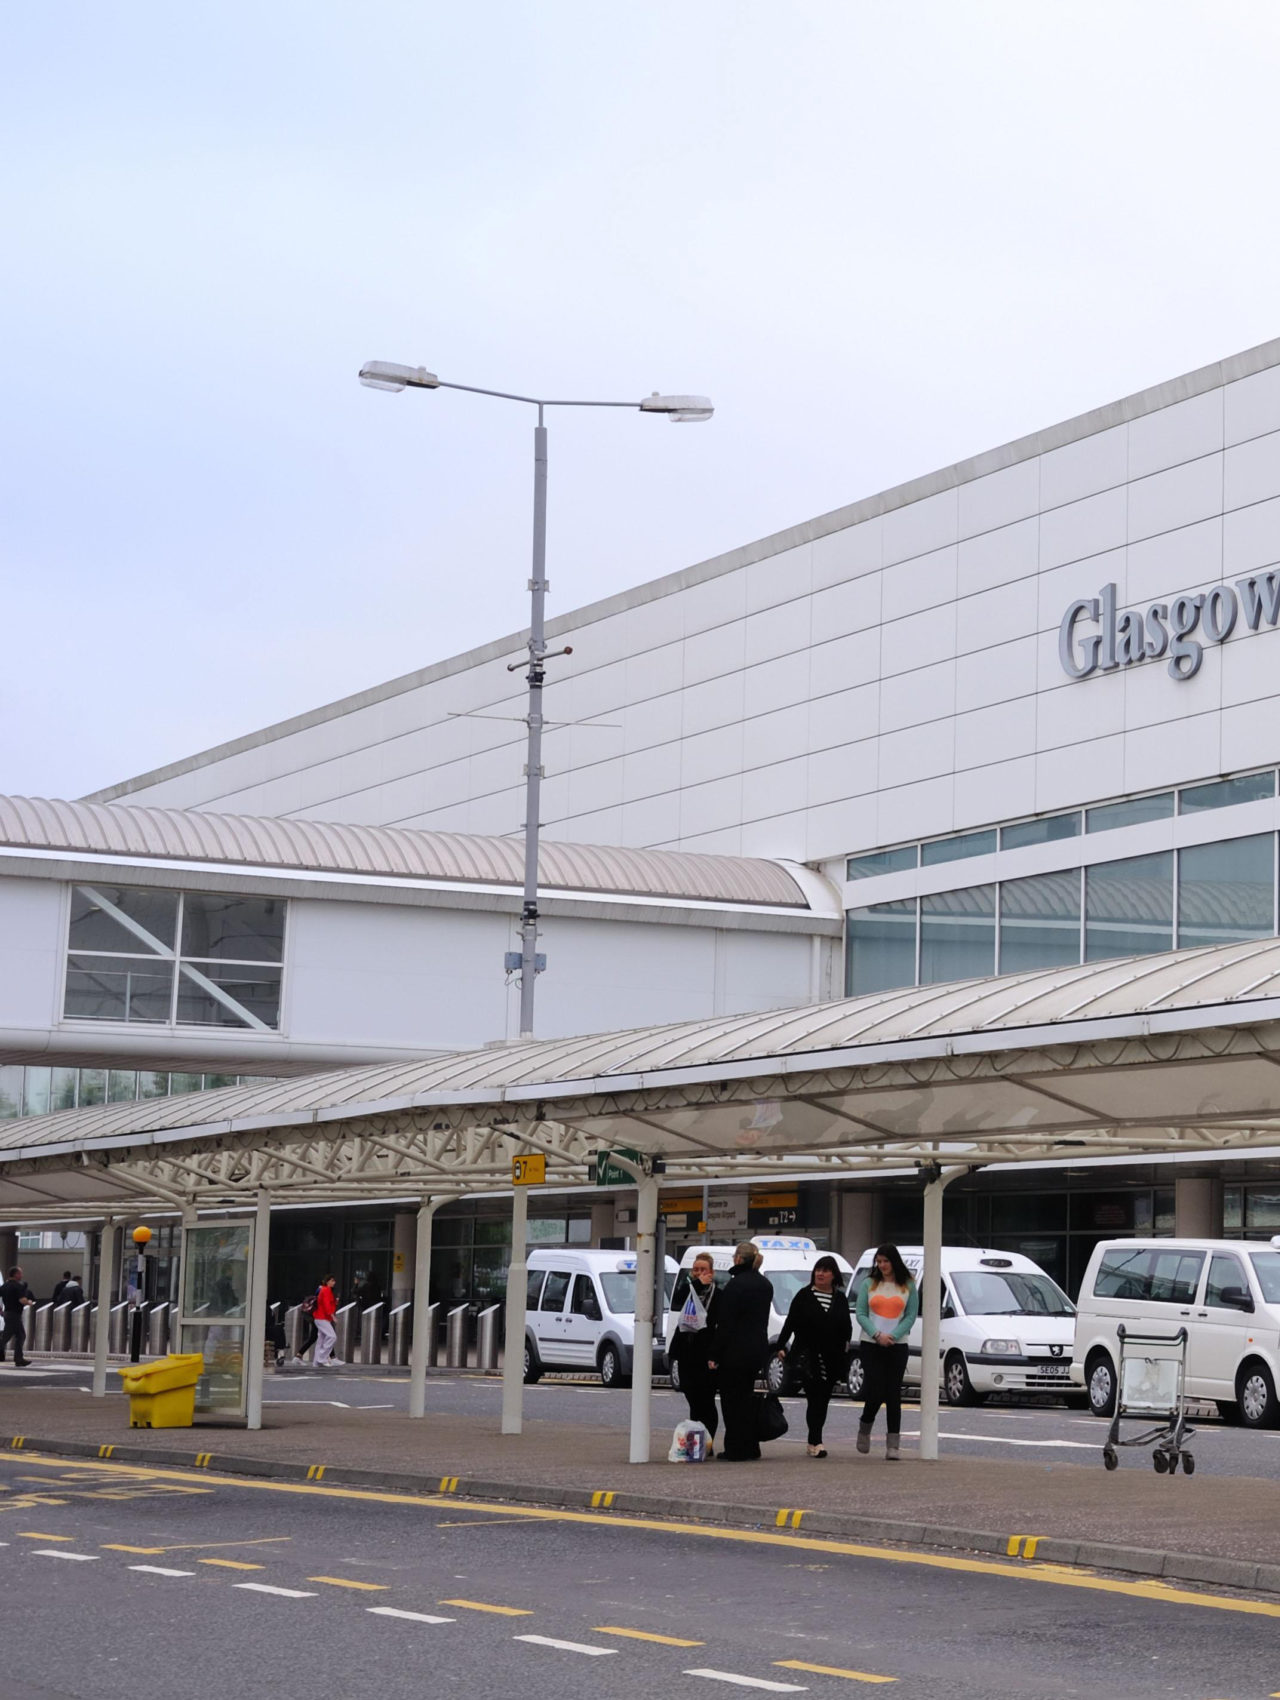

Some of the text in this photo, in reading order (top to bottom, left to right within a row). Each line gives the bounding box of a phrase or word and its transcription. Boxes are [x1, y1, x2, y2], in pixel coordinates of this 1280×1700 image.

[522, 1160, 528, 1179] 7
[779, 1210, 789, 1224] T2
[760, 1240, 810, 1249] TAXI
